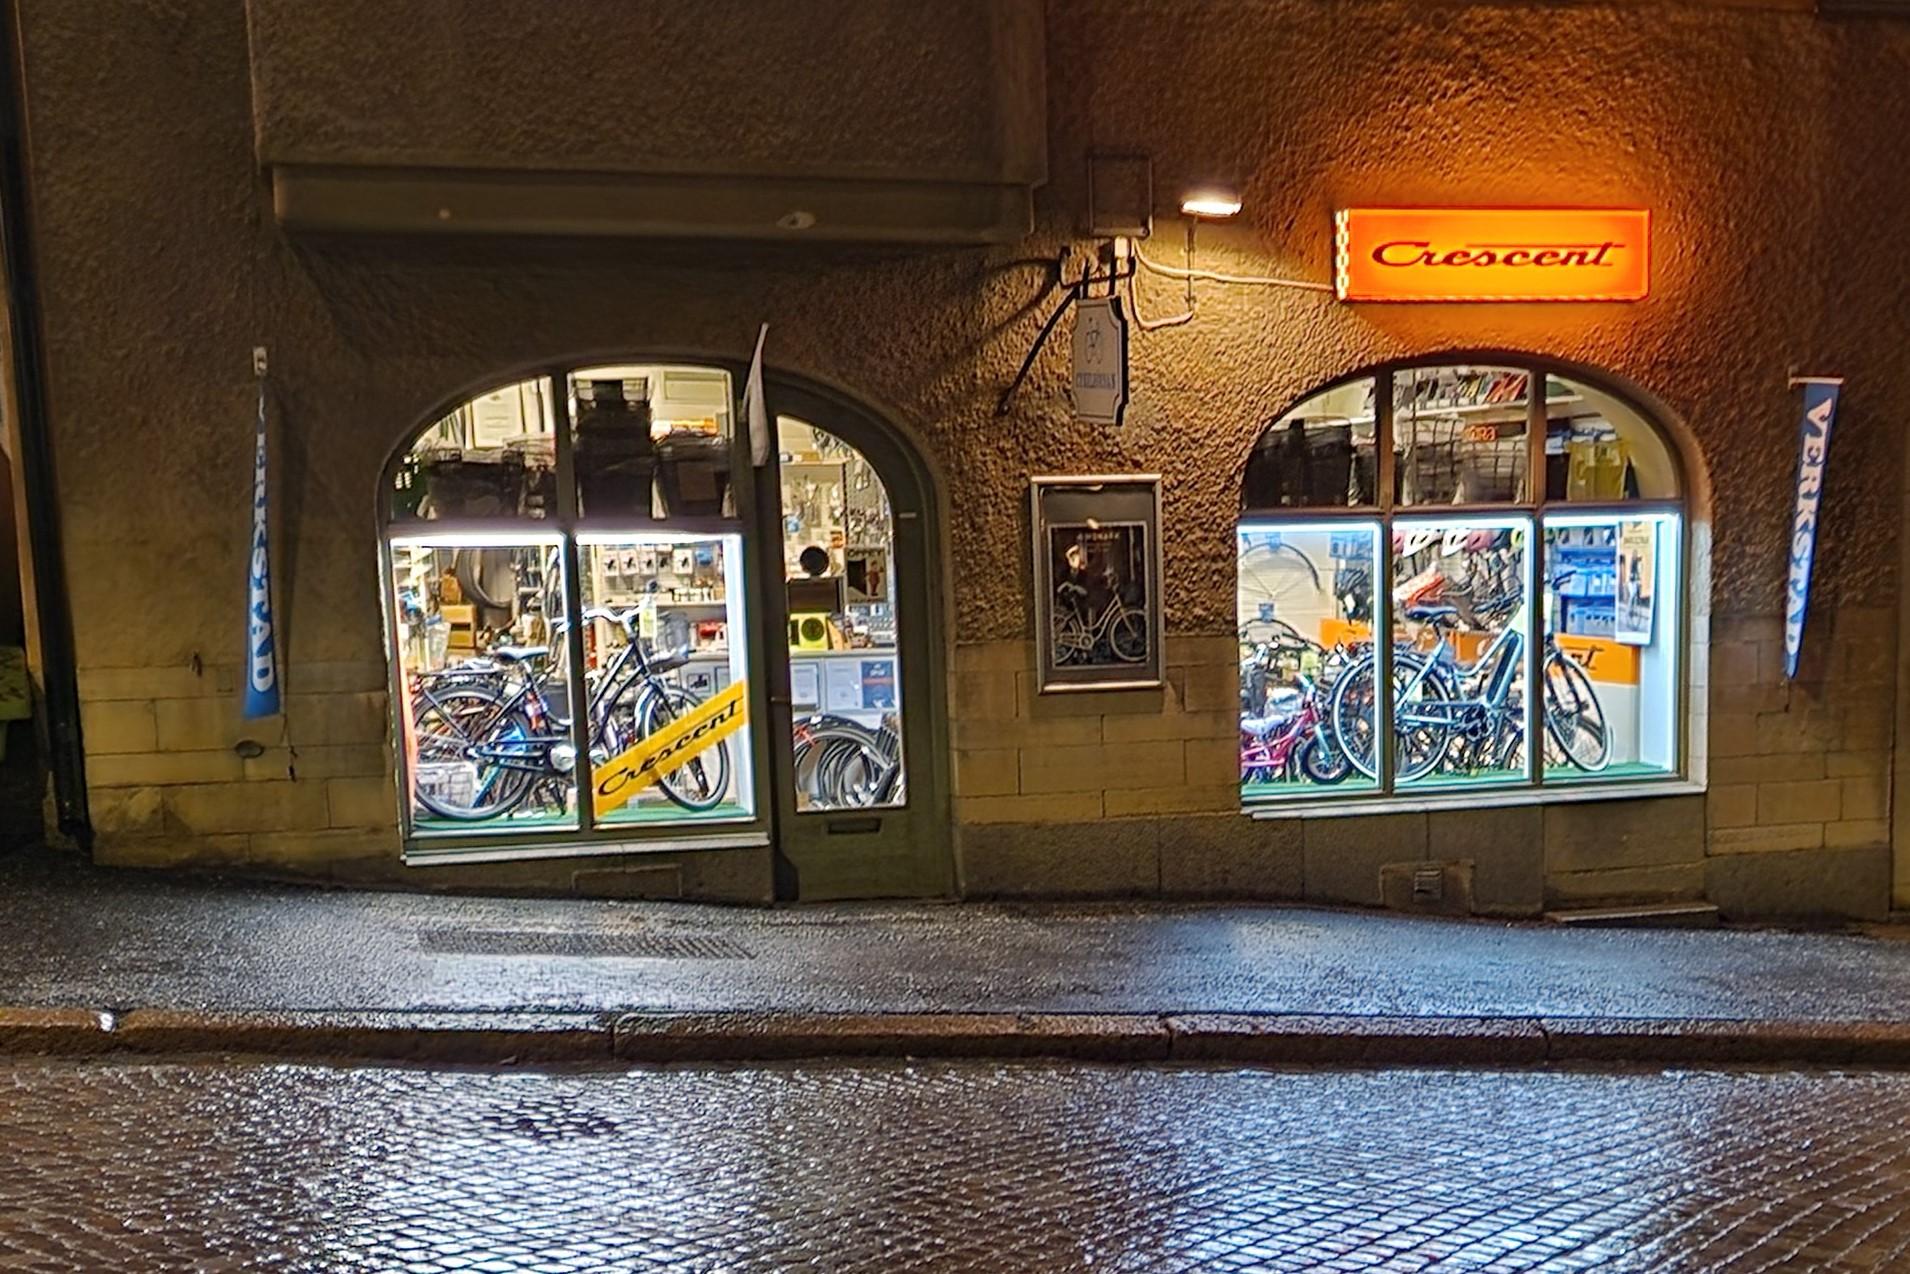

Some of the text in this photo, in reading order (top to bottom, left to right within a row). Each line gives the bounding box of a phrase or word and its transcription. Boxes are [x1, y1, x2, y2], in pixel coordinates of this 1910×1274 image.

[1371, 241, 1626, 267] Crescent
[1785, 397, 1833, 656] VERKSTAD
[597, 695, 744, 797] Crescent
